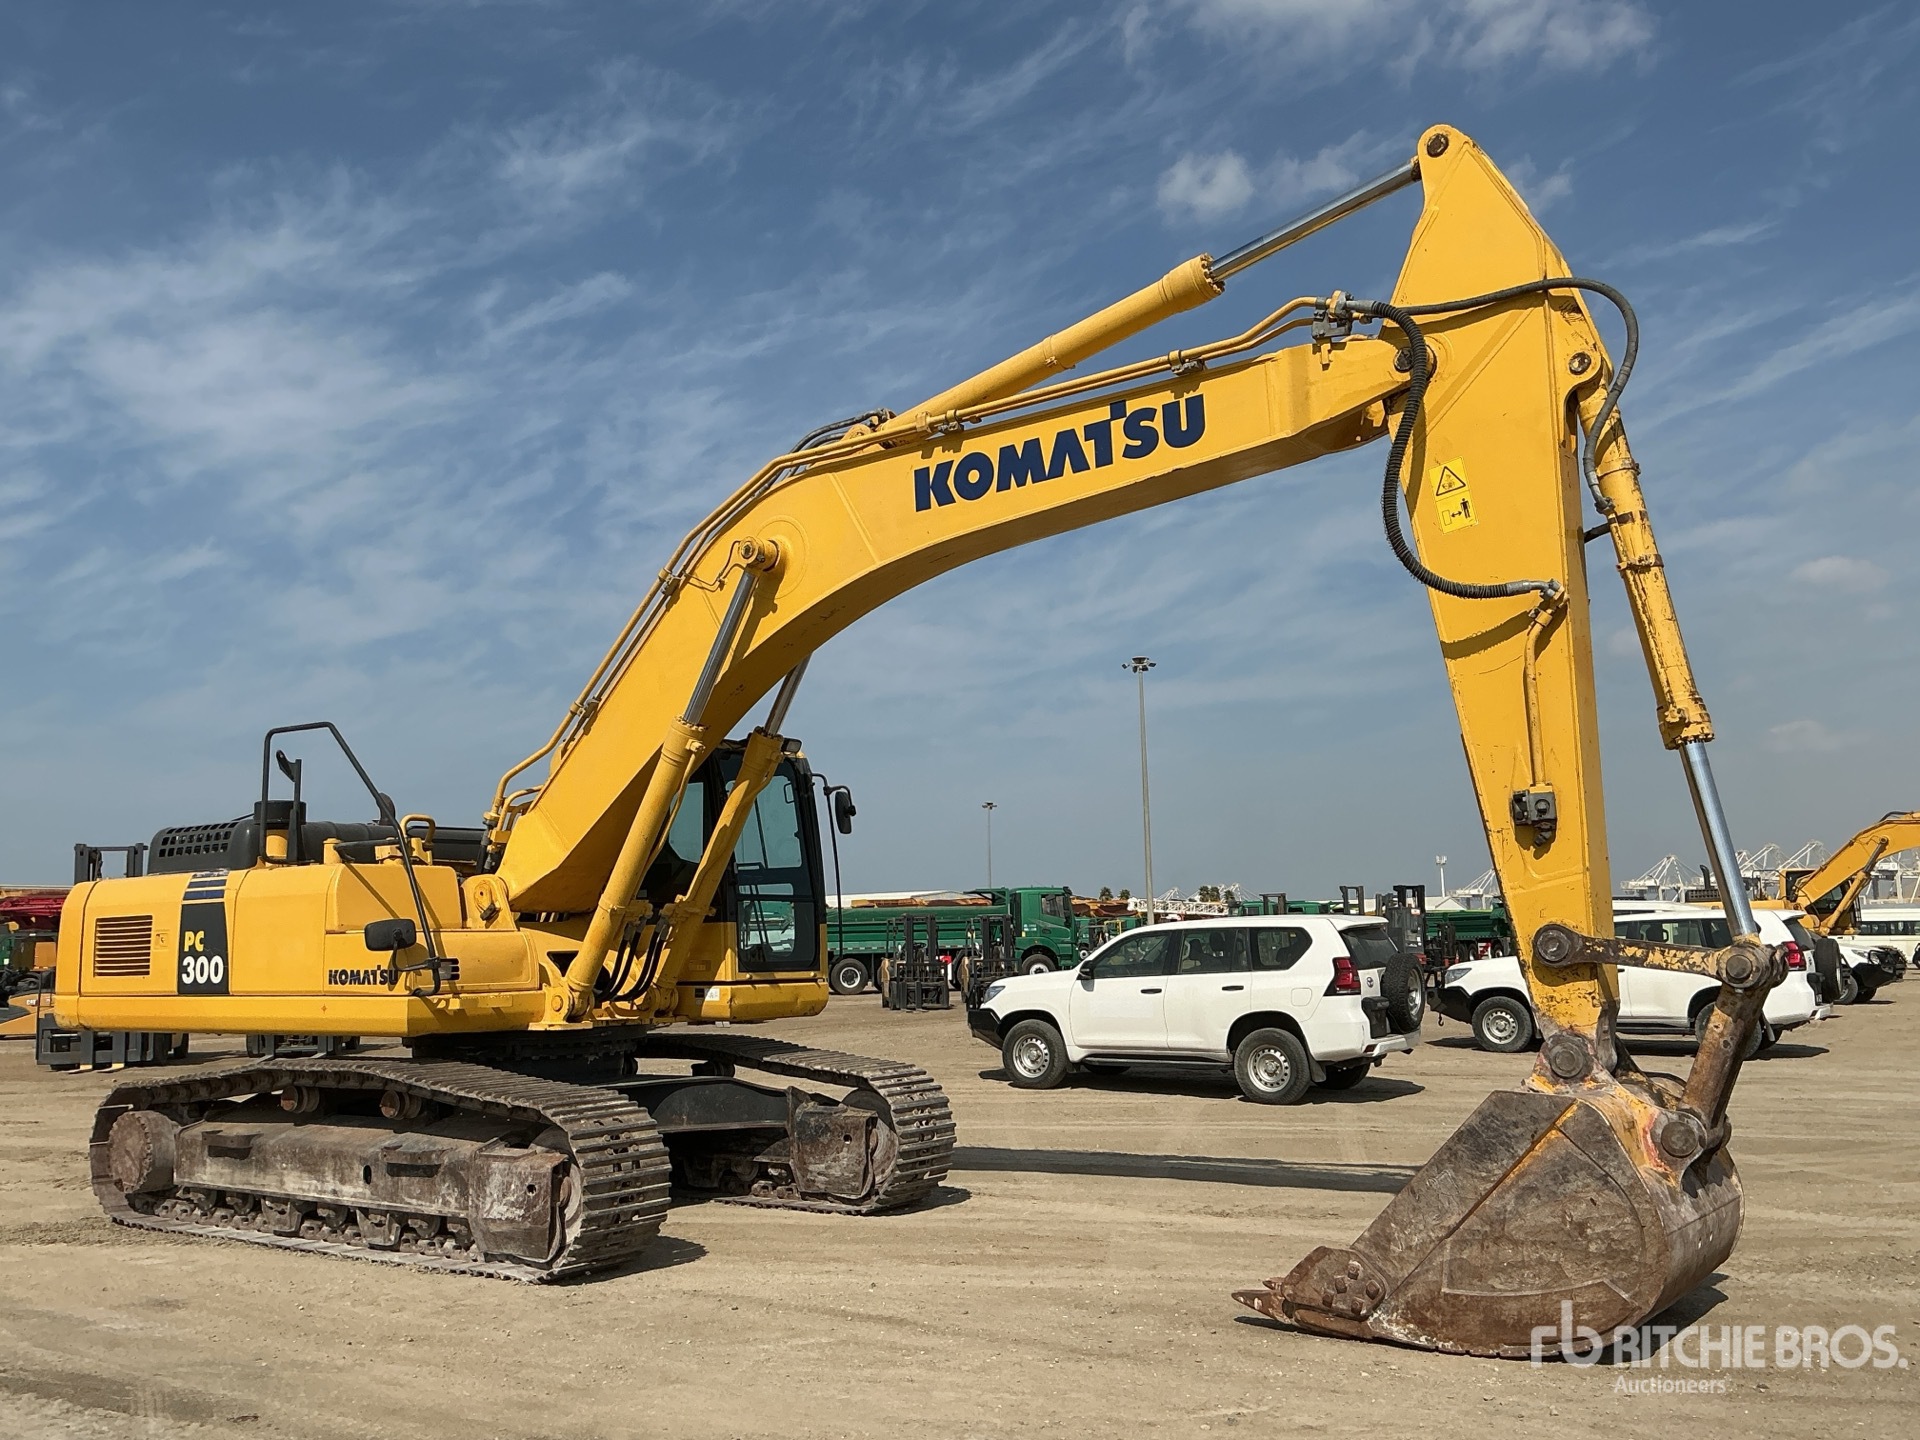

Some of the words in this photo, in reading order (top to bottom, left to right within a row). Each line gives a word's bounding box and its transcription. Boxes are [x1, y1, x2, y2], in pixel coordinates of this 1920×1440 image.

[914, 394, 1206, 512] KOMATSU
[184, 931, 205, 952] PC
[181, 955, 224, 984] 300
[328, 964, 398, 985] KOMATSU
